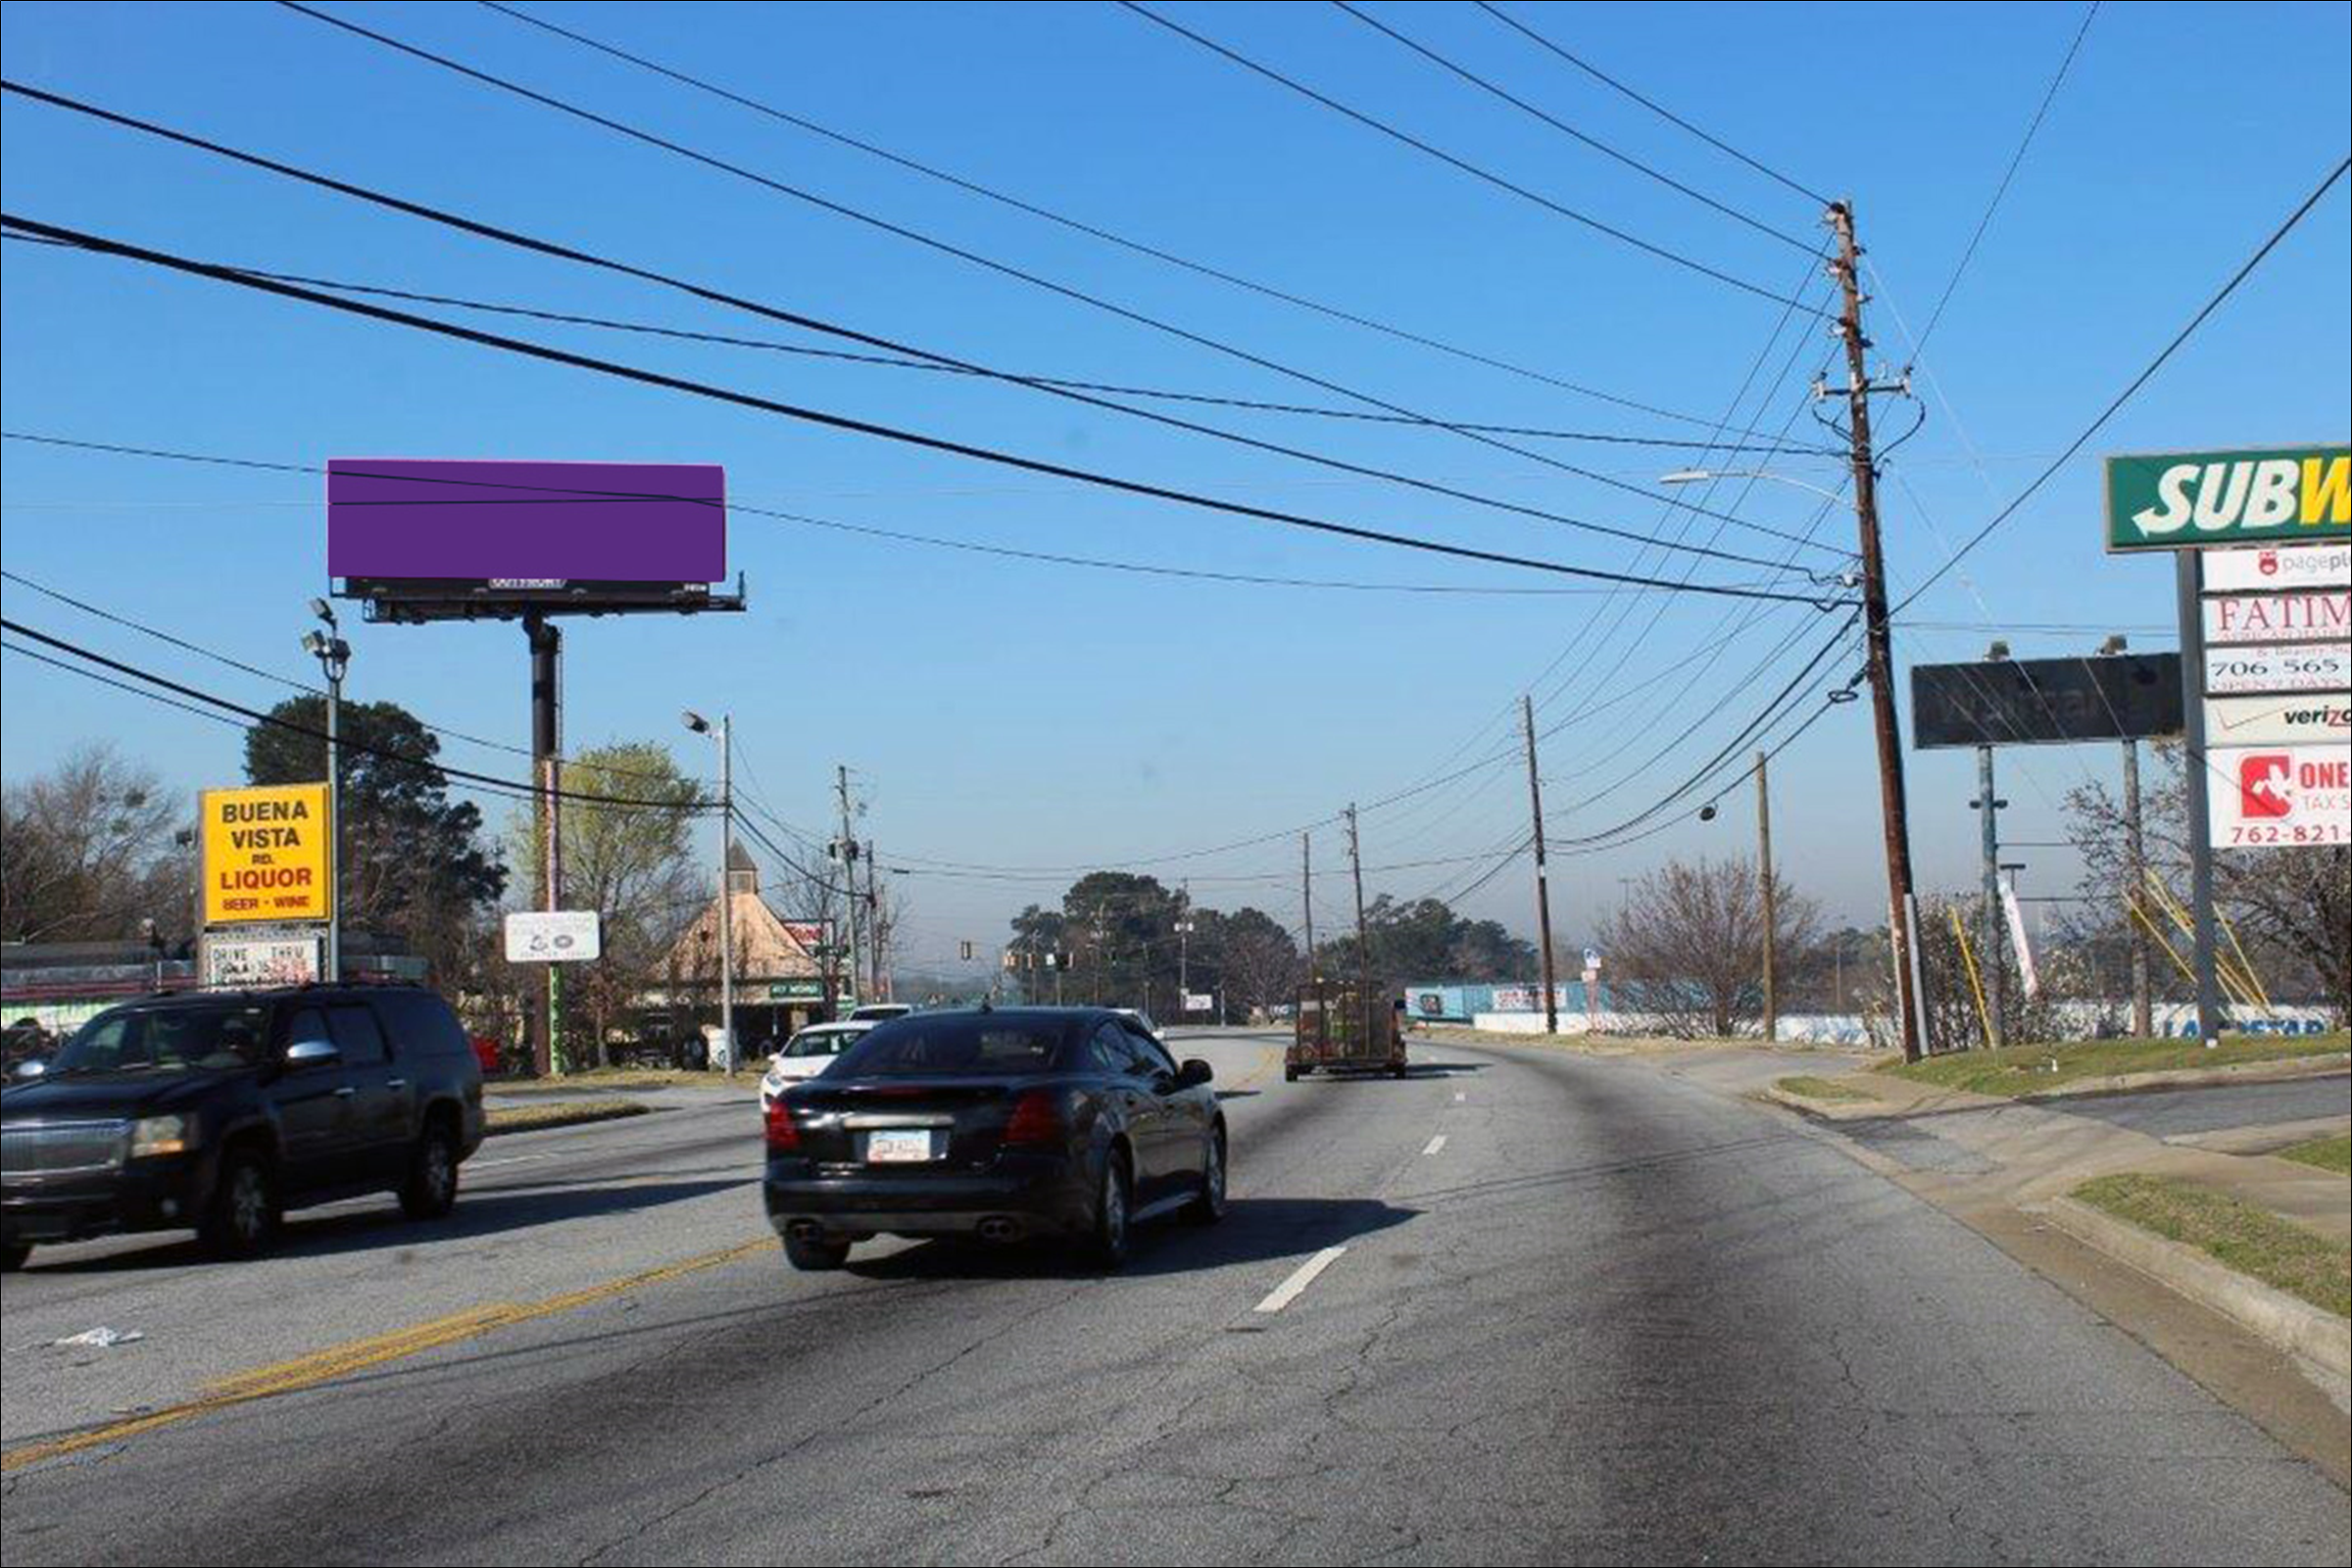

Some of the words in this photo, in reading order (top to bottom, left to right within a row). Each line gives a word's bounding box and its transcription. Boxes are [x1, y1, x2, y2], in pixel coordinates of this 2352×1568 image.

[2282, 552, 2351, 573] pagepl
[2211, 662, 2268, 677] 706
[2283, 659, 2339, 674] 565
[2299, 761, 2350, 789] ONE
[221, 801, 309, 823] BUENA
[2303, 796, 2334, 810] TAX
[231, 827, 301, 849] VISTA
[252, 855, 274, 864] RD.
[220, 868, 313, 890] LIQUOR
[221, 898, 259, 910] BEER
[273, 896, 311, 907] WINE
